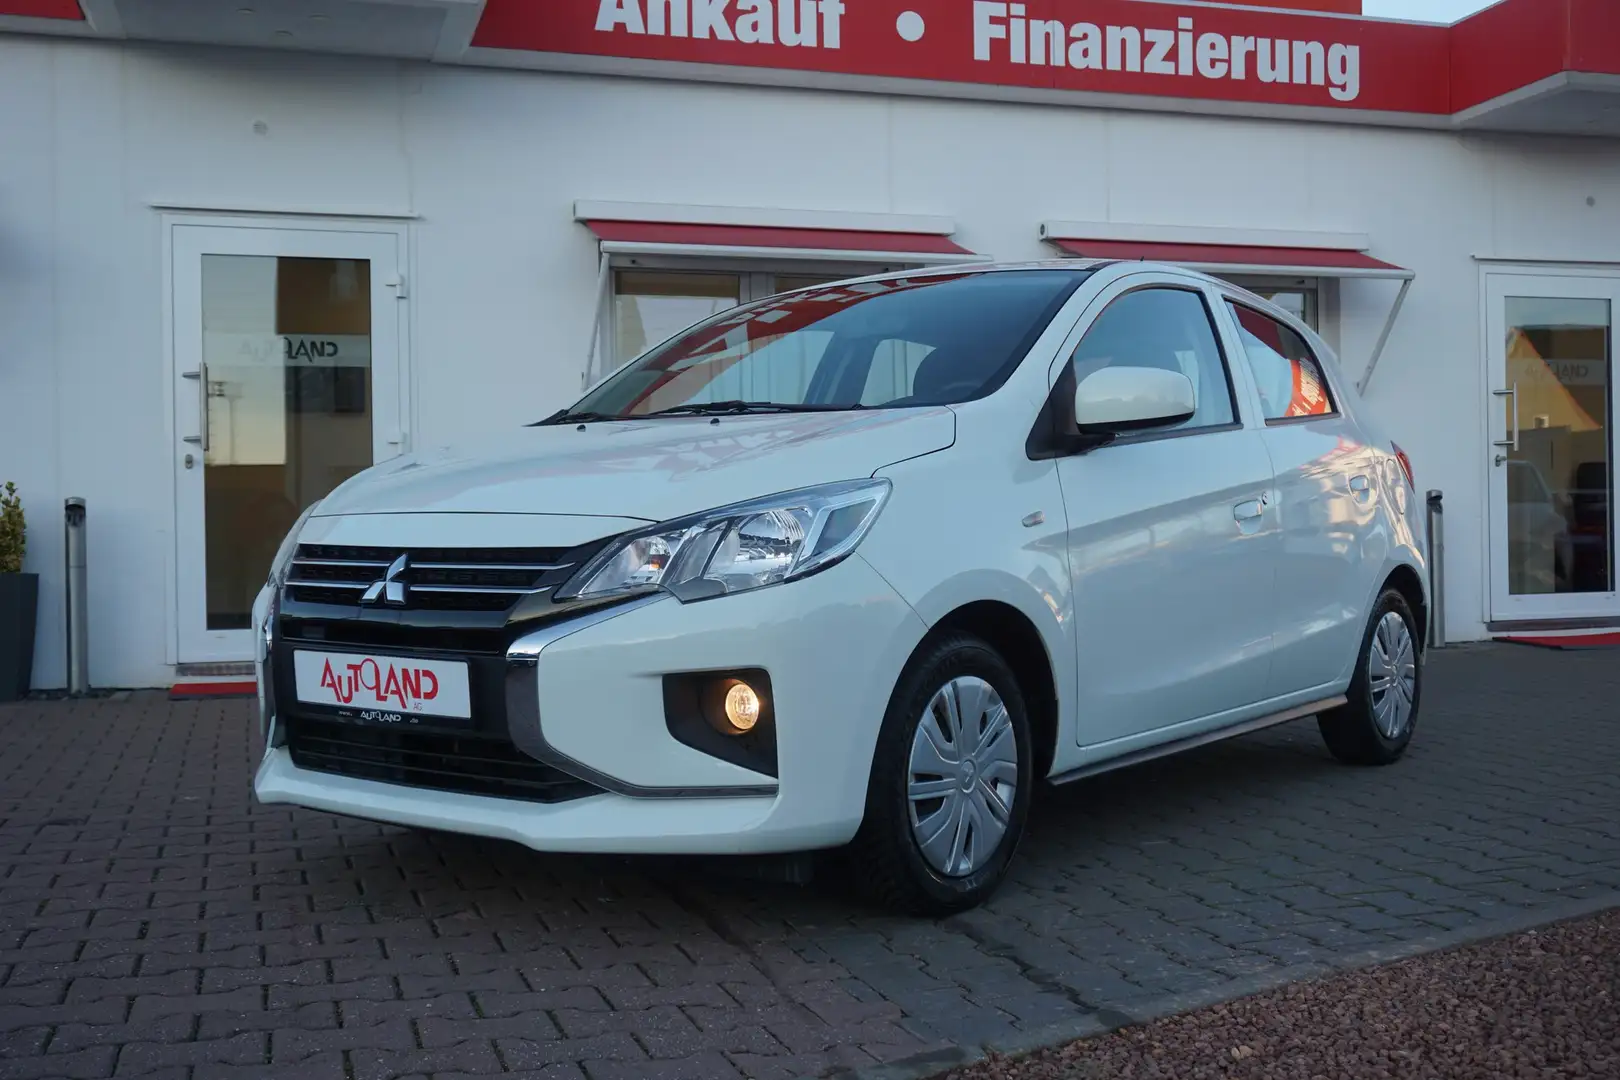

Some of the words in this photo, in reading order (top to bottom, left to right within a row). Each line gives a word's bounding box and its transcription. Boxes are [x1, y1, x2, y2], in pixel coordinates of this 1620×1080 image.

[595, 0, 845, 49] Ankauf
[973, 0, 1360, 101] Finanzierung
[320, 657, 439, 709] AUTOLAND
[360, 711, 402, 723] AUTOLAND
